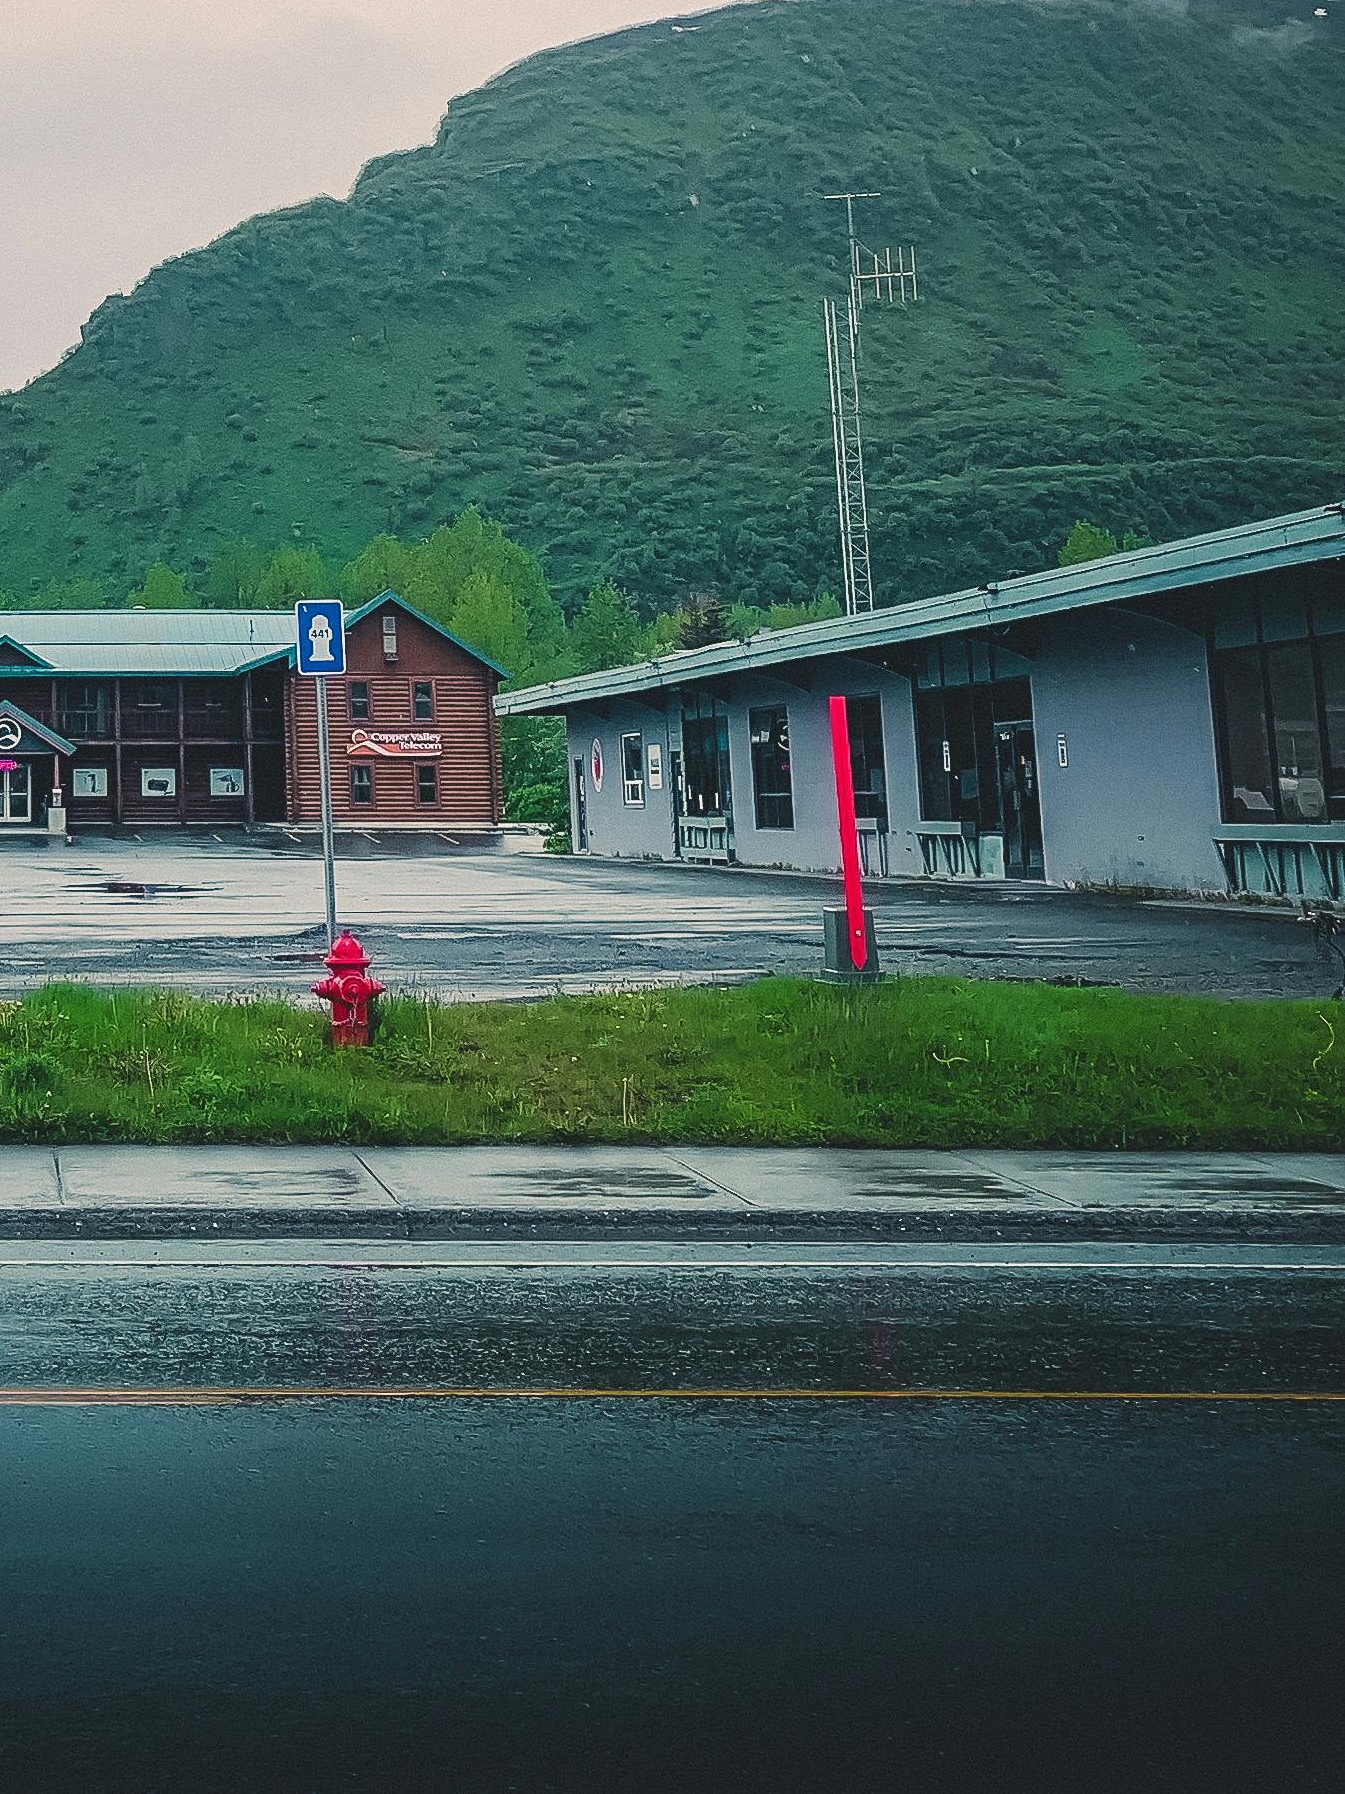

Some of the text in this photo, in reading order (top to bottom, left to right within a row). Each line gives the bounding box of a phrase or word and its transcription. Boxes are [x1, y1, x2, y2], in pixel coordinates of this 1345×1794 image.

[311, 629, 330, 639] 441
[370, 732, 441, 743] Copper Valley
[399, 741, 442, 750] Telecom
